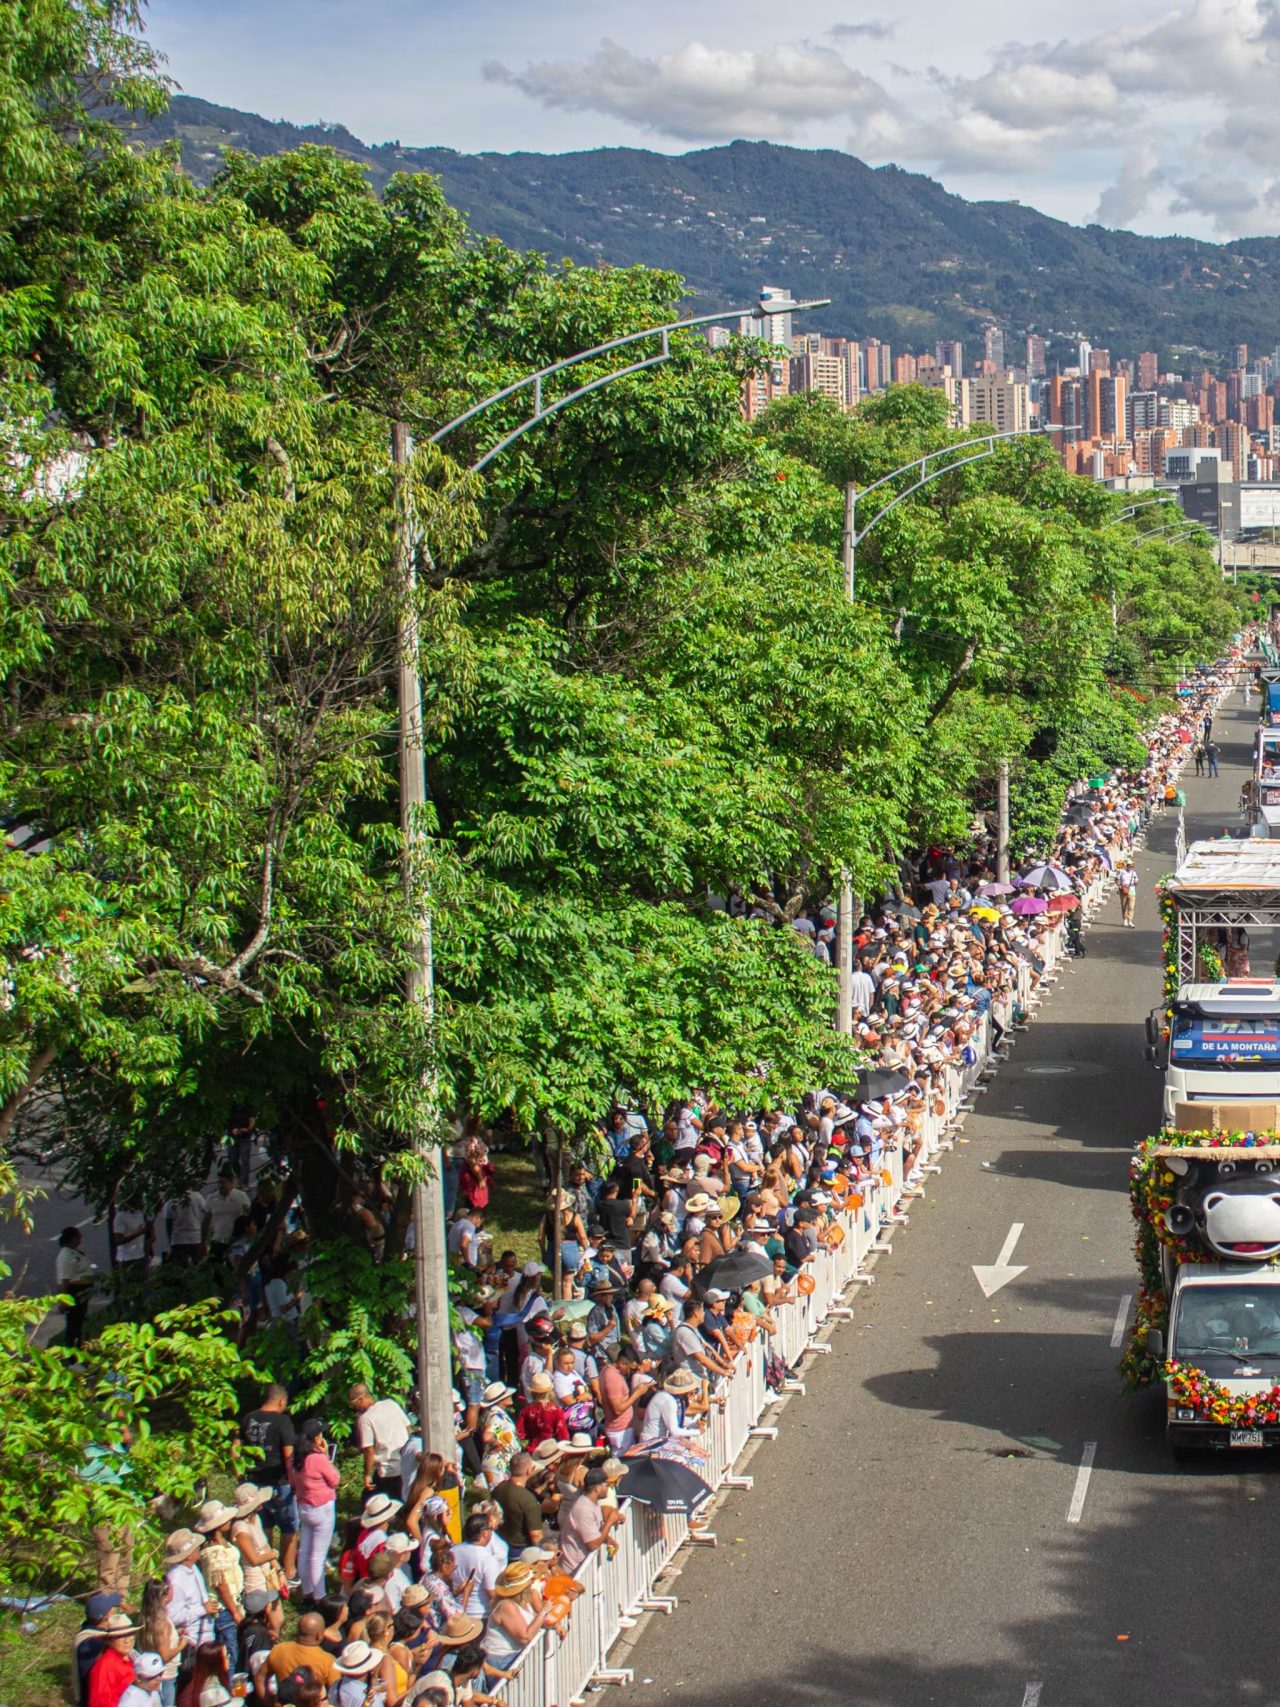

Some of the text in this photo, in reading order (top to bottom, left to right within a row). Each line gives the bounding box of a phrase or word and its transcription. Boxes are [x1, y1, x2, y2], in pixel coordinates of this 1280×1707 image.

[1202, 1043, 1217, 1051] DE
[1218, 1043, 1229, 1051] LA
[1231, 1041, 1277, 1052] MONTAÑA
[1247, 1433, 1260, 1442] 751
